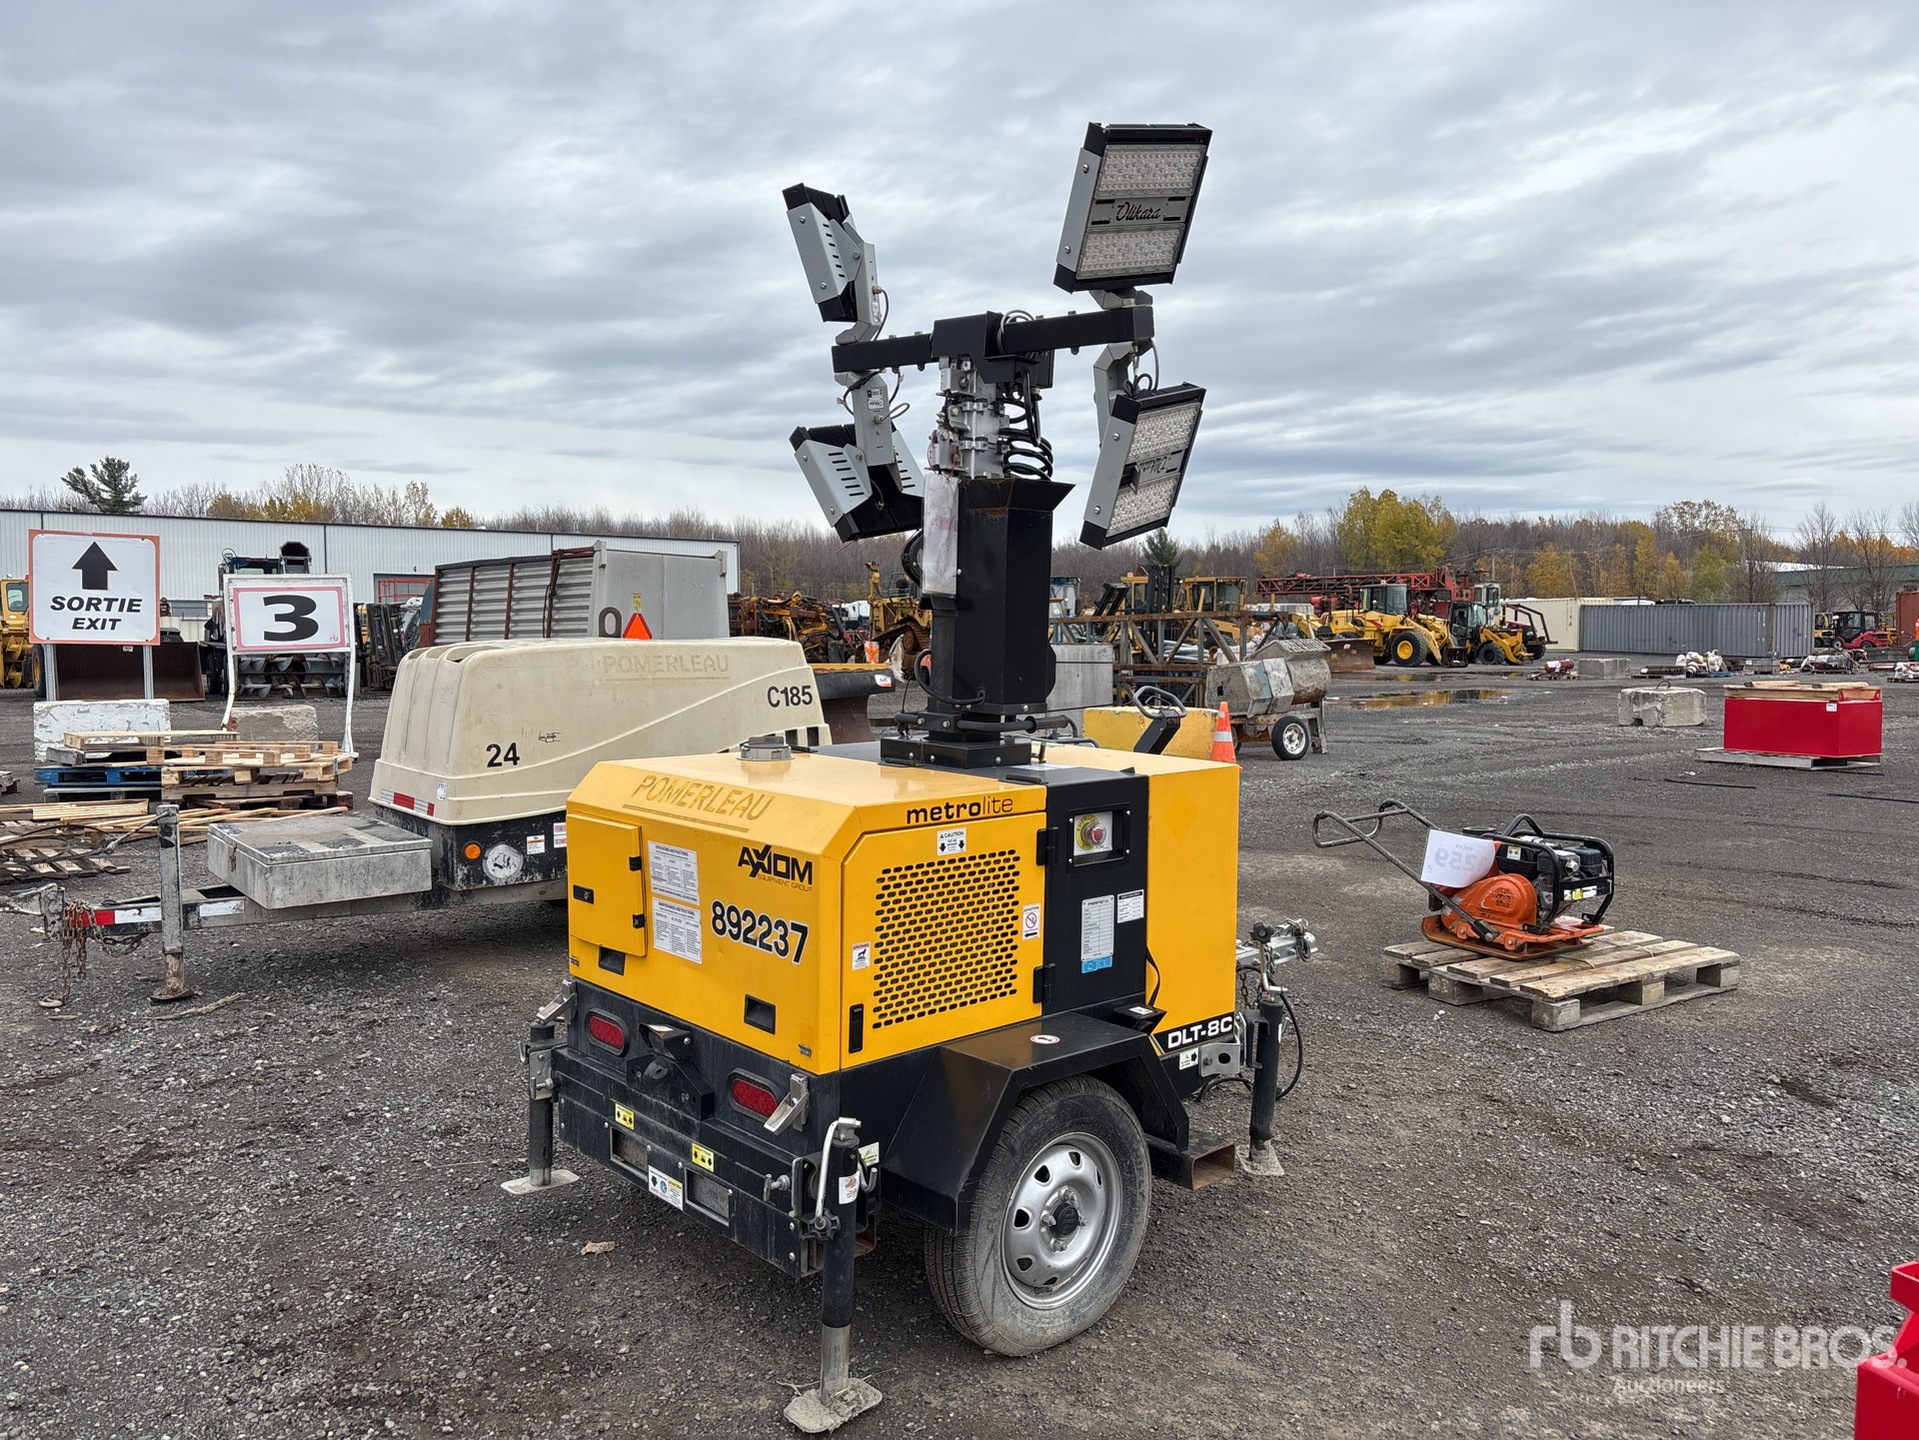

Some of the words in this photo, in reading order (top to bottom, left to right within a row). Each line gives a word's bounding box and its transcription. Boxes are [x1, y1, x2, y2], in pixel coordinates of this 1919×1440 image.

[50, 595, 143, 614] SORTIE
[263, 594, 319, 642] 3
[72, 617, 121, 631] EXIT
[603, 654, 730, 675] POMERLEAU
[766, 684, 813, 708] C185
[486, 742, 520, 768] 24
[632, 775, 776, 821] POMERLEAU
[906, 795, 1014, 825] metrolite
[738, 844, 813, 885] AXIOM
[757, 873, 790, 887] EQUIPMENT
[791, 882, 813, 892] GROUP
[711, 900, 809, 965] 892237
[1167, 1016, 1233, 1049] DLT-8C
